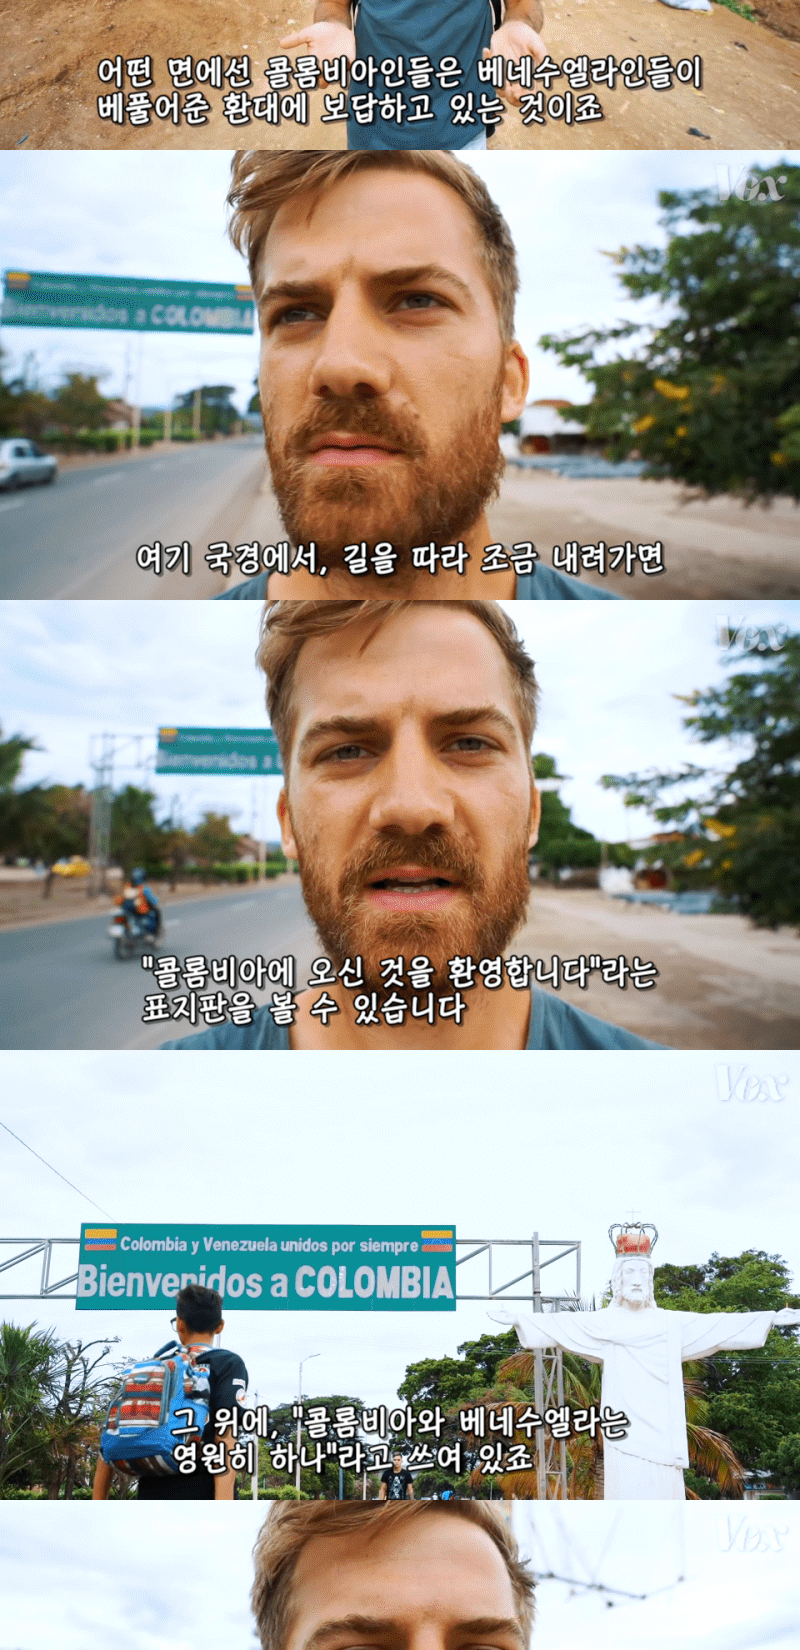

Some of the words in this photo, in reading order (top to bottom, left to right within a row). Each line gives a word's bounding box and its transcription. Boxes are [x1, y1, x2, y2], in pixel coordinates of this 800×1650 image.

[120, 1236, 187, 1252] Colombia
[190, 1240, 199, 1255] y
[203, 1236, 278, 1252] Venezuela
[280, 1237, 328, 1253] unidos
[331, 1239, 356, 1256] por
[359, 1238, 419, 1256] siempre
[270, 1272, 289, 1299] a
[294, 1264, 455, 1300] COLOMBIA
